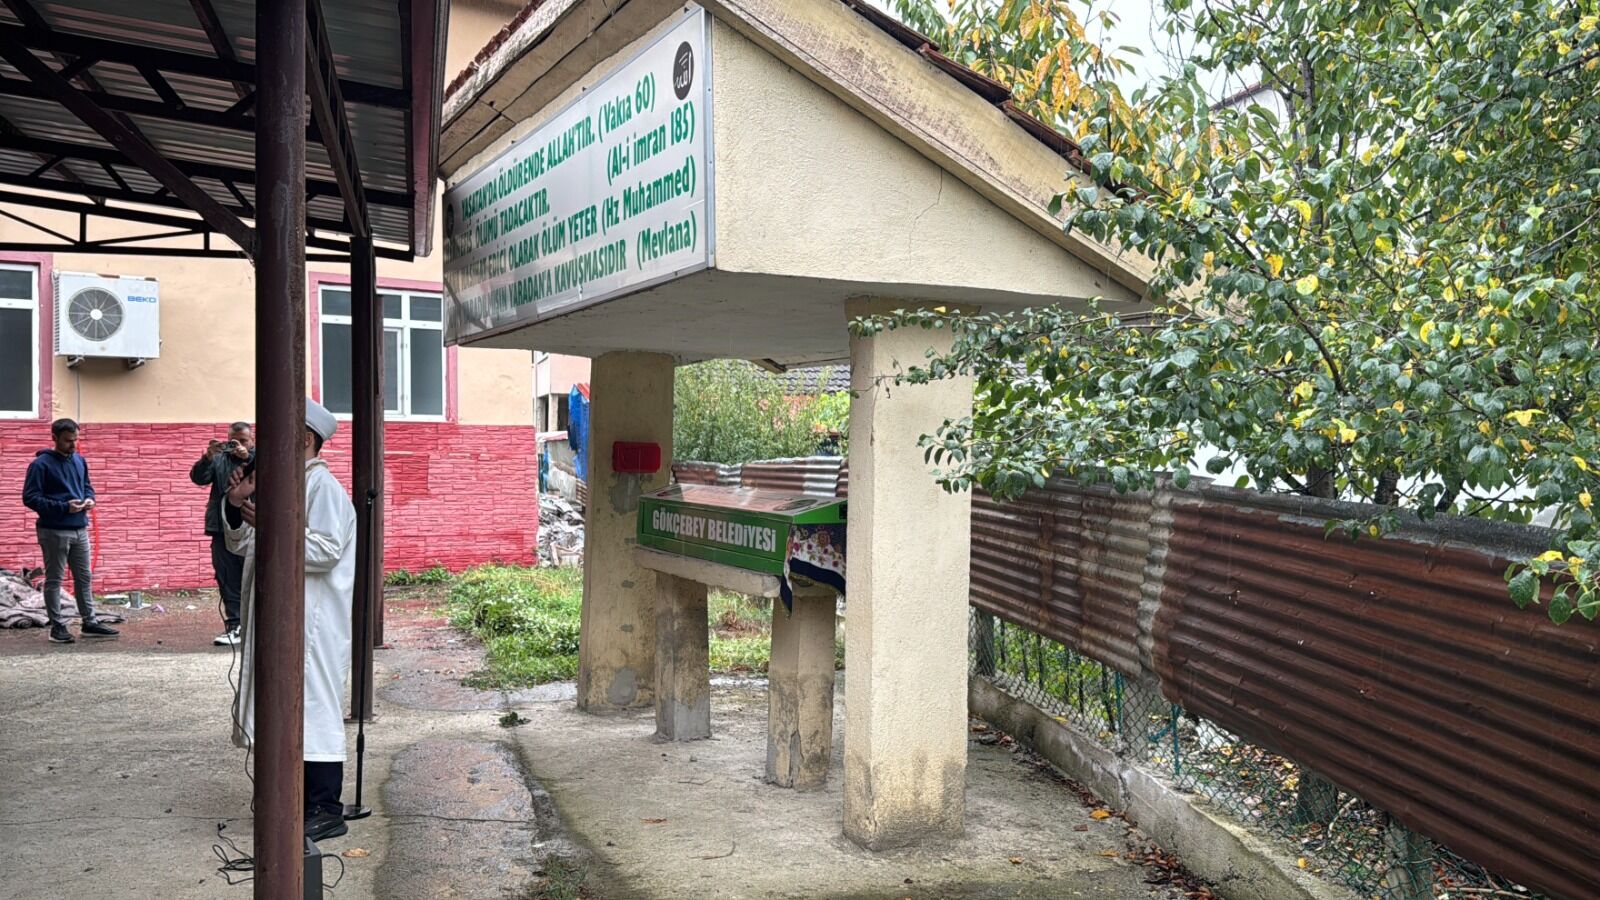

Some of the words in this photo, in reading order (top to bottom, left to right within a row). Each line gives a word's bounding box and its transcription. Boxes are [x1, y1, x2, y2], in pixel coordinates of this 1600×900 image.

[500, 188, 550, 236] TADACAKTIR.
[633, 124, 666, 167] imran
[671, 101, 695, 146] 185)
[547, 116, 595, 172] ALLAH'TIR.
[598, 96, 632, 143] (Vakıa
[635, 72, 655, 113] 60)
[508, 272, 551, 308] YARADAN'A
[554, 239, 627, 293] KAVUŞMASIDIR
[637, 210, 697, 270] (Mevlana)
[509, 232, 540, 271] OLARAK
[541, 216, 566, 257] ÖLÜM
[568, 204, 598, 245] YETER
[601, 196, 619, 236] (Hz
[623, 154, 696, 221] Muhammed)
[652, 507, 707, 539] GÖKÇEBEY
